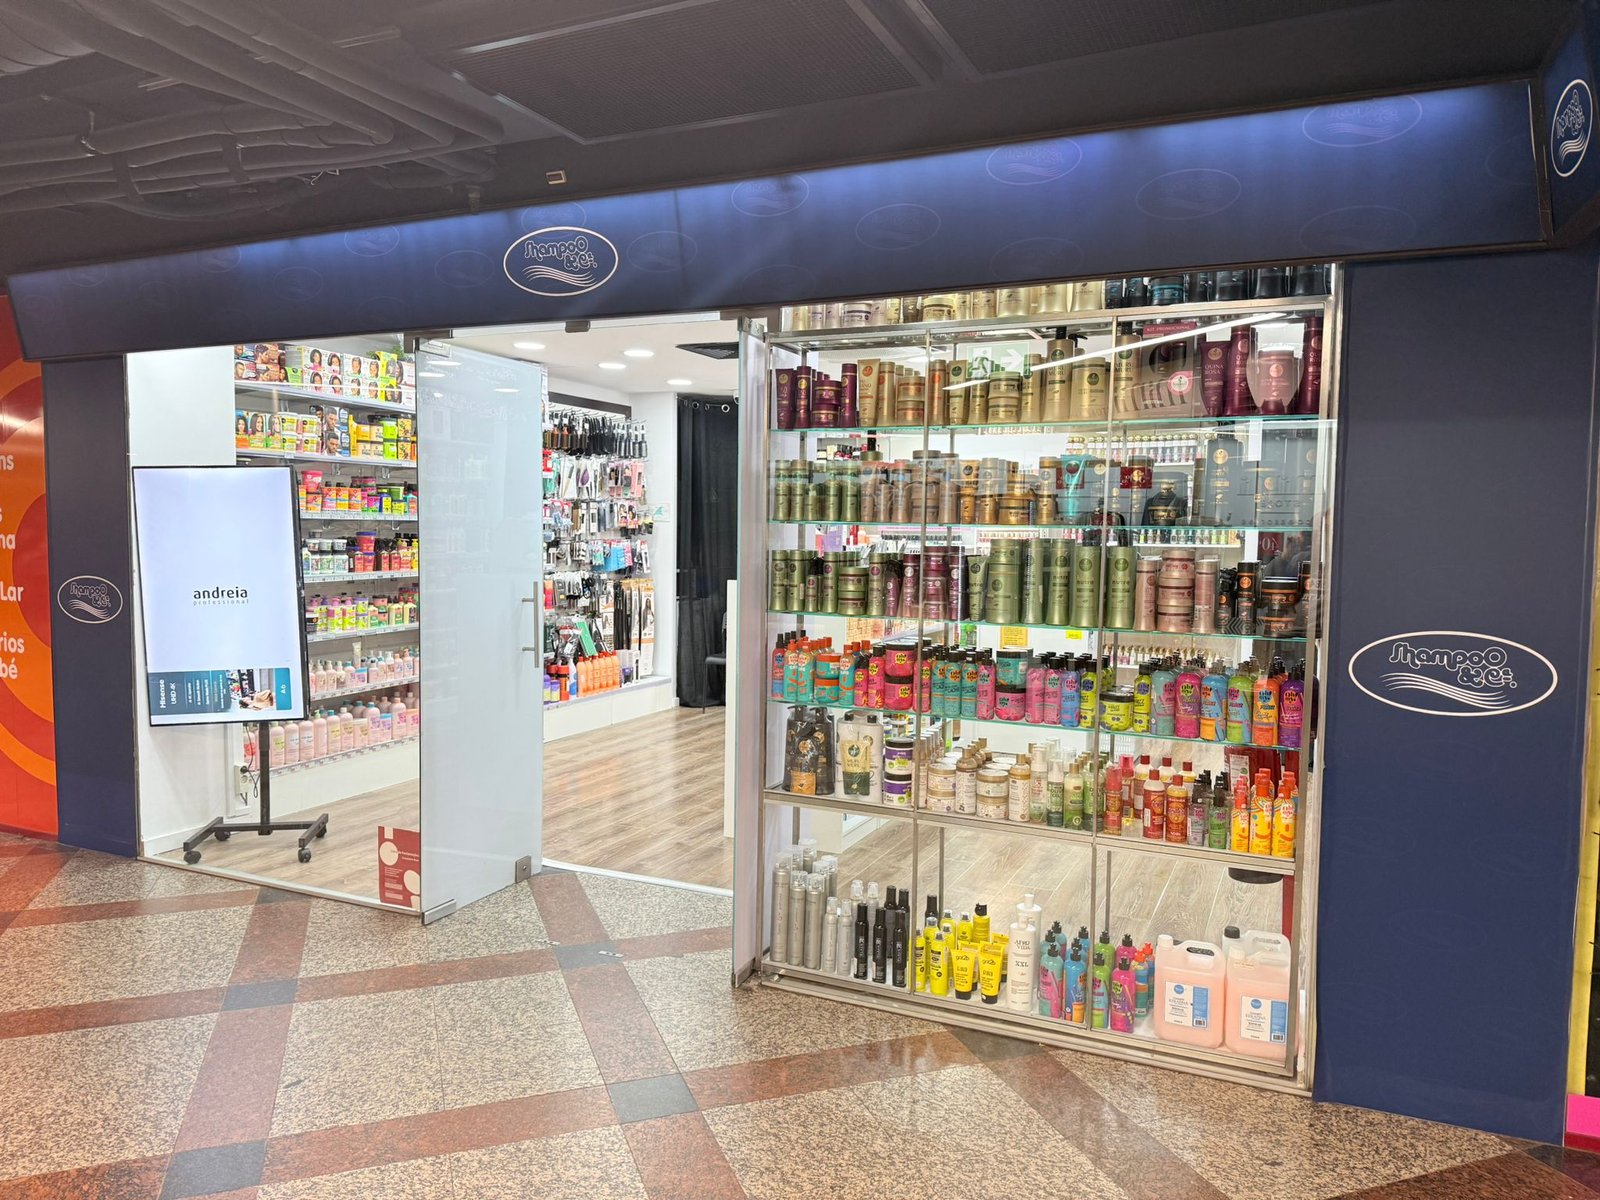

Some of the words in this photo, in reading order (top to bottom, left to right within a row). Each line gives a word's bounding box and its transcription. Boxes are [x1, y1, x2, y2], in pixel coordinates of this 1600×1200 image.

[0, 581, 25, 602] Lar
[193, 586, 249, 600] andreia
[192, 599, 249, 607] professional
[1015, 960, 1029, 968] XXL
